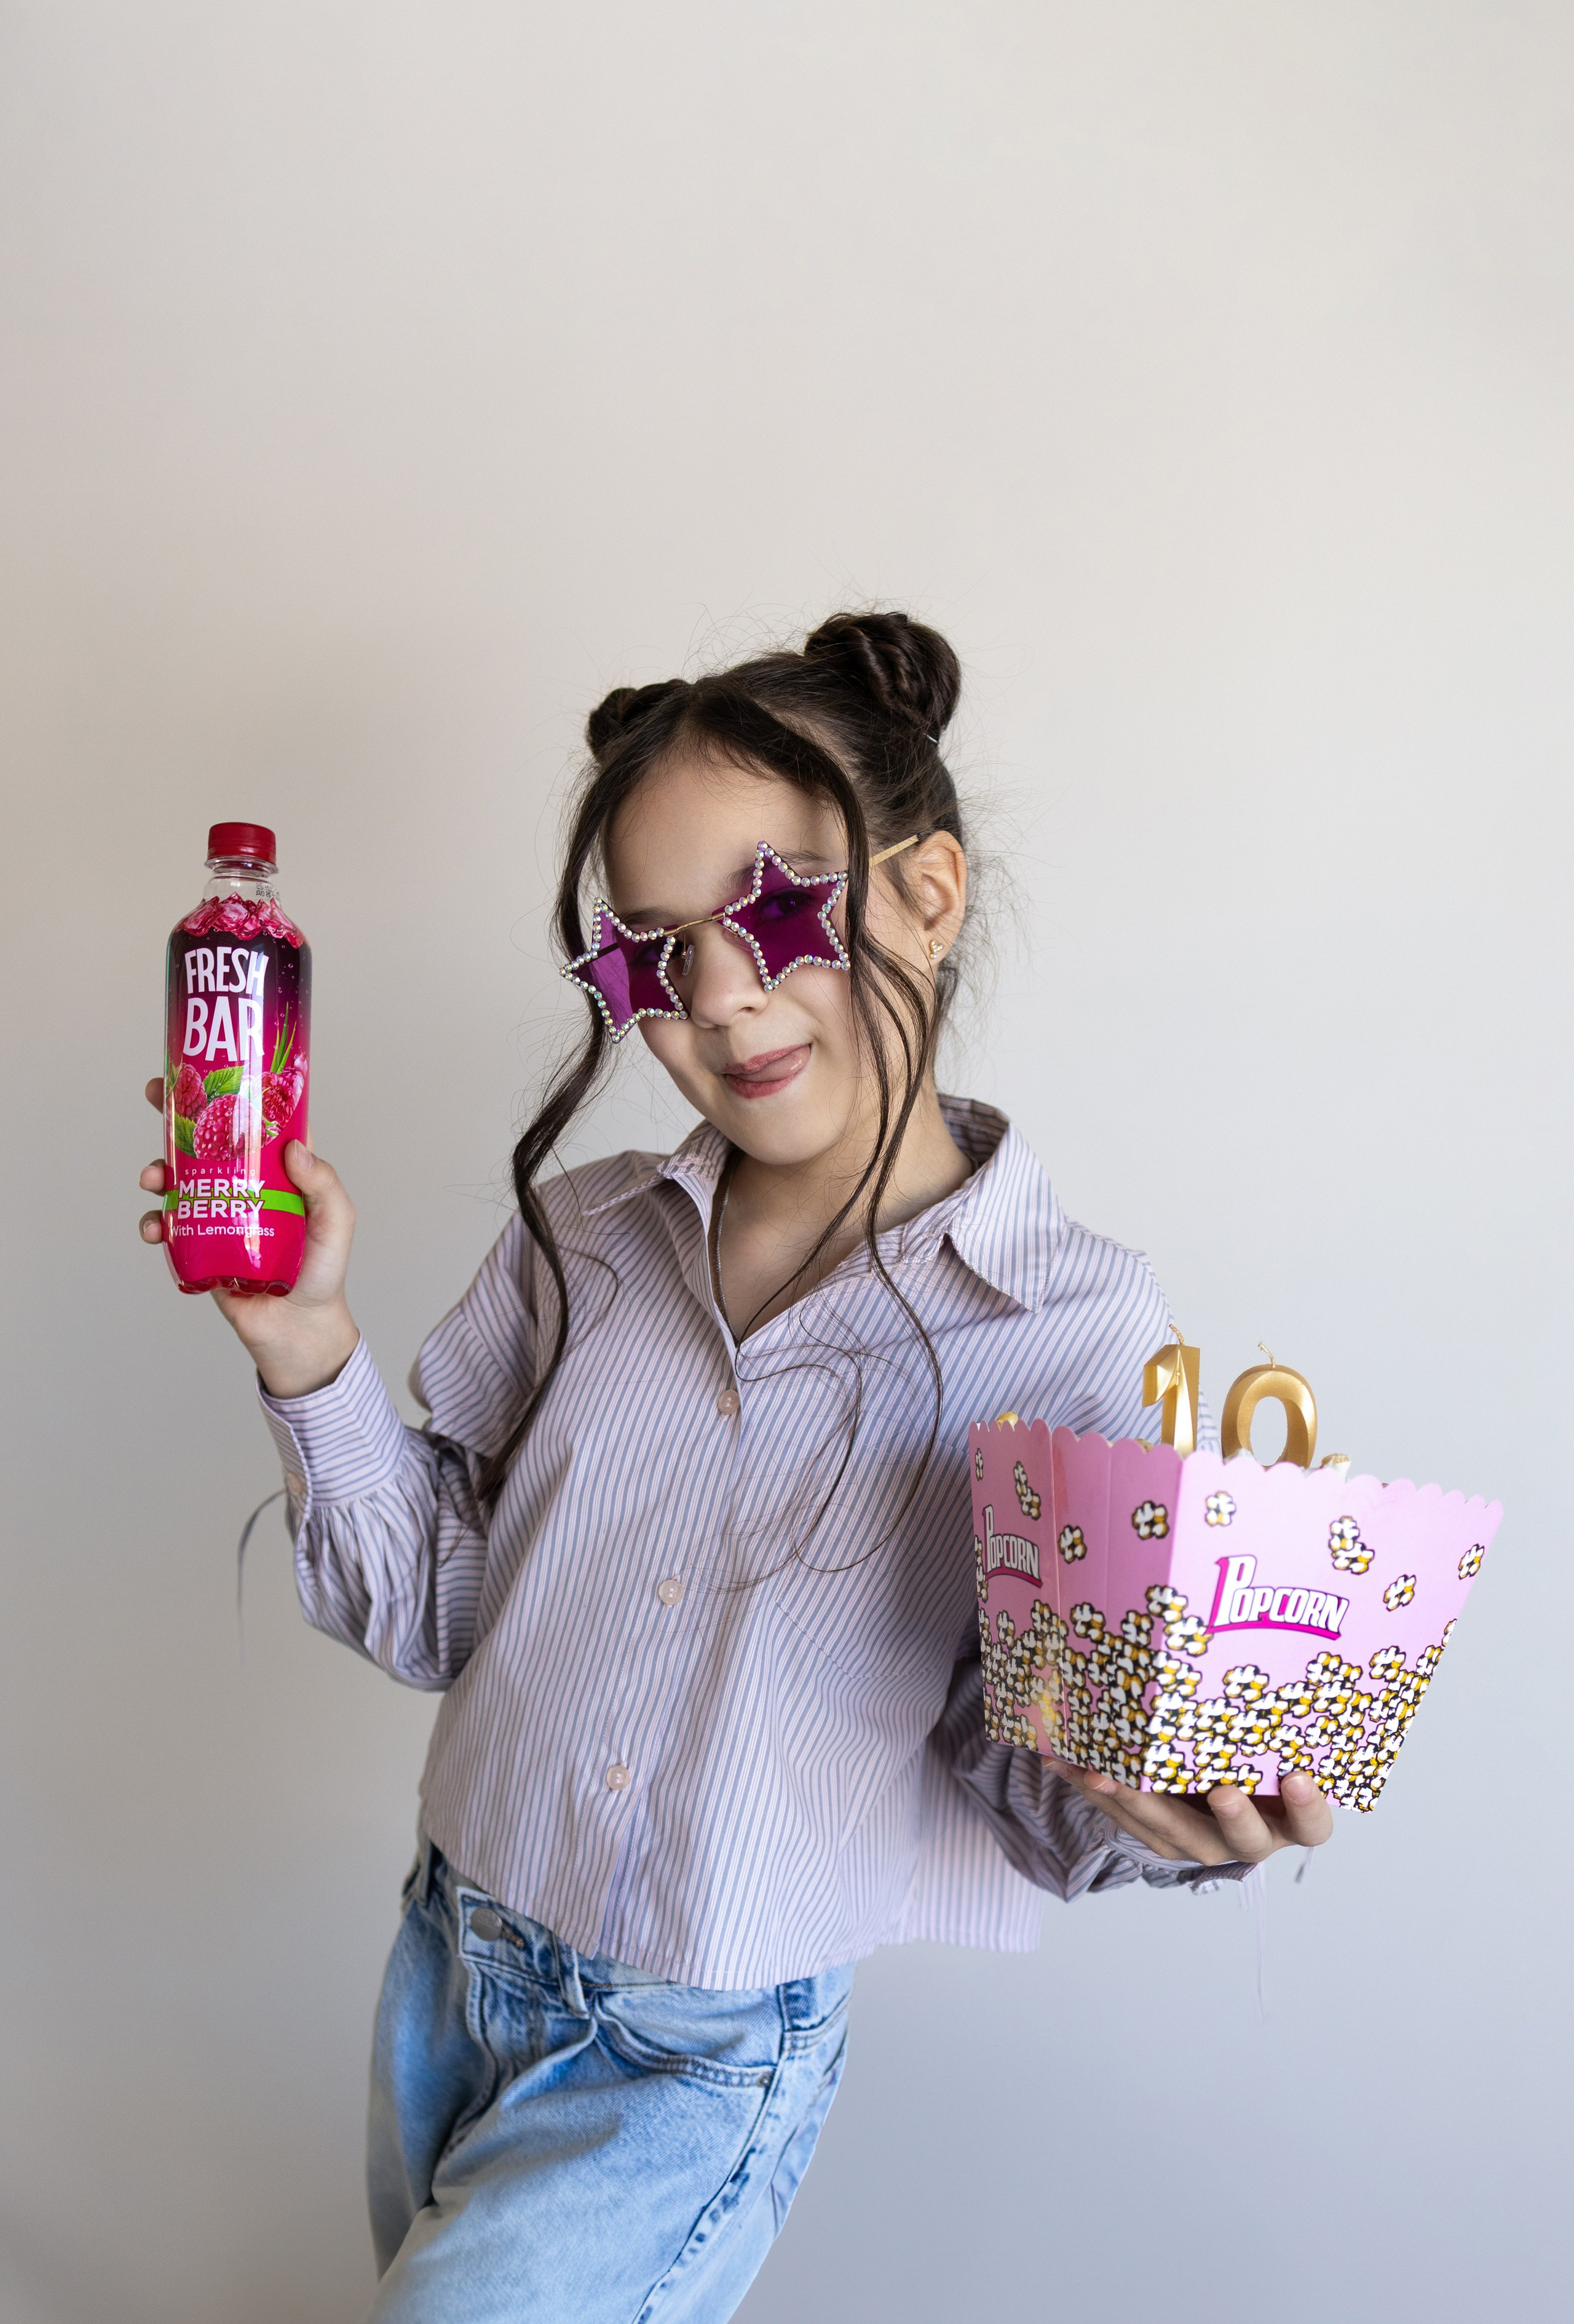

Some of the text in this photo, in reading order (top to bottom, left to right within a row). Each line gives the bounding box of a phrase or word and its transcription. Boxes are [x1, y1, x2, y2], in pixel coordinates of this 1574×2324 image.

[184, 946, 269, 997] FRESH
[183, 996, 265, 1062] BAR
[184, 1167, 256, 1177] sparkling
[178, 1179, 266, 1199] MERRY
[177, 1200, 265, 1220] BERRY
[171, 1224, 275, 1238] With Lemongrass
